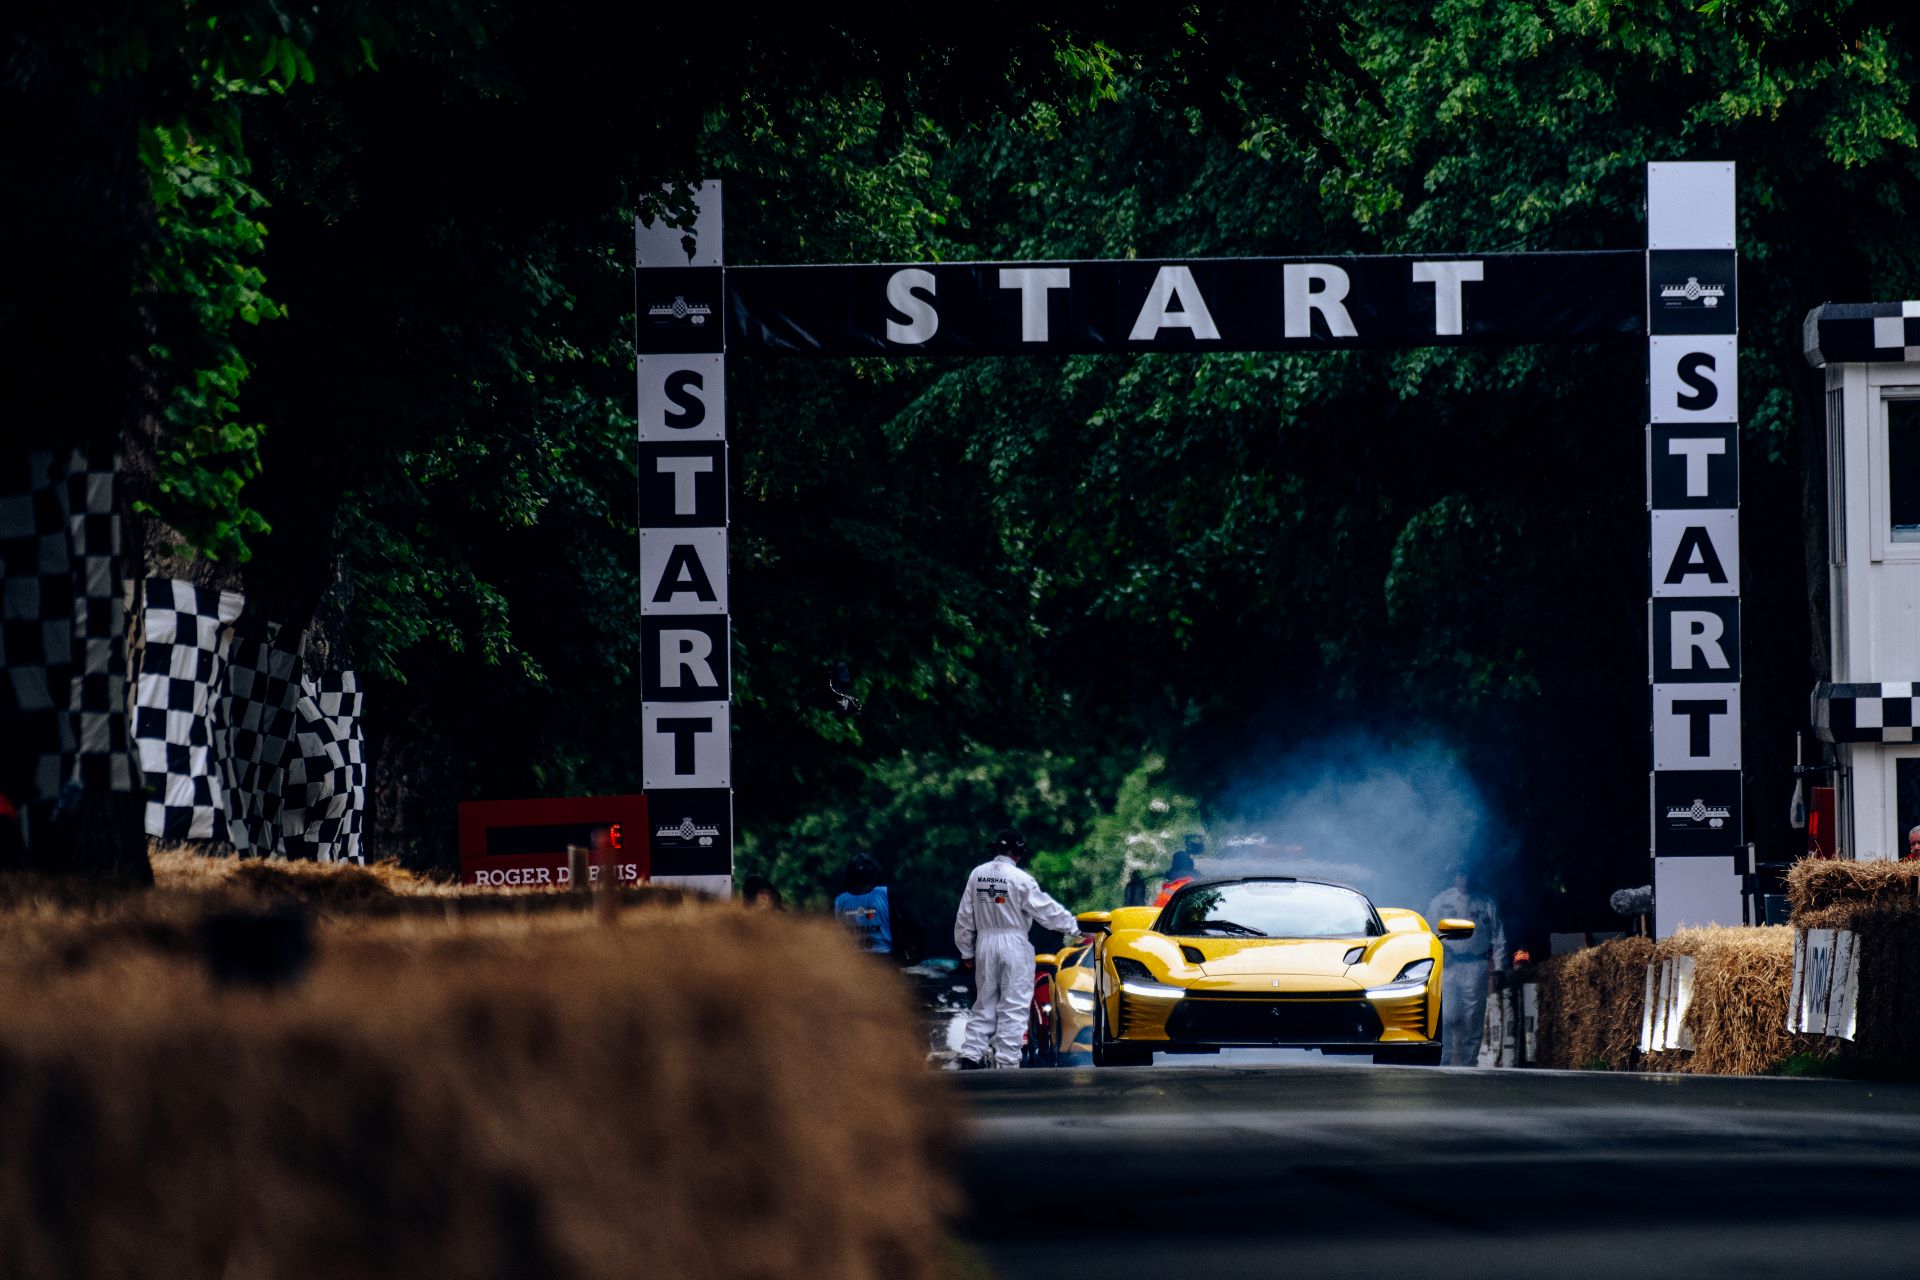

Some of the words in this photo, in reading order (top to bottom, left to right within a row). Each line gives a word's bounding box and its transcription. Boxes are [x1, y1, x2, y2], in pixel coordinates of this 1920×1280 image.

[886, 259, 1485, 345] START
[656, 369, 719, 776] START
[1663, 351, 1730, 758] START
[475, 867, 551, 886] ROGER
[557, 864, 638, 883] DBIS
[977, 876, 1008, 885] MARSHAL
